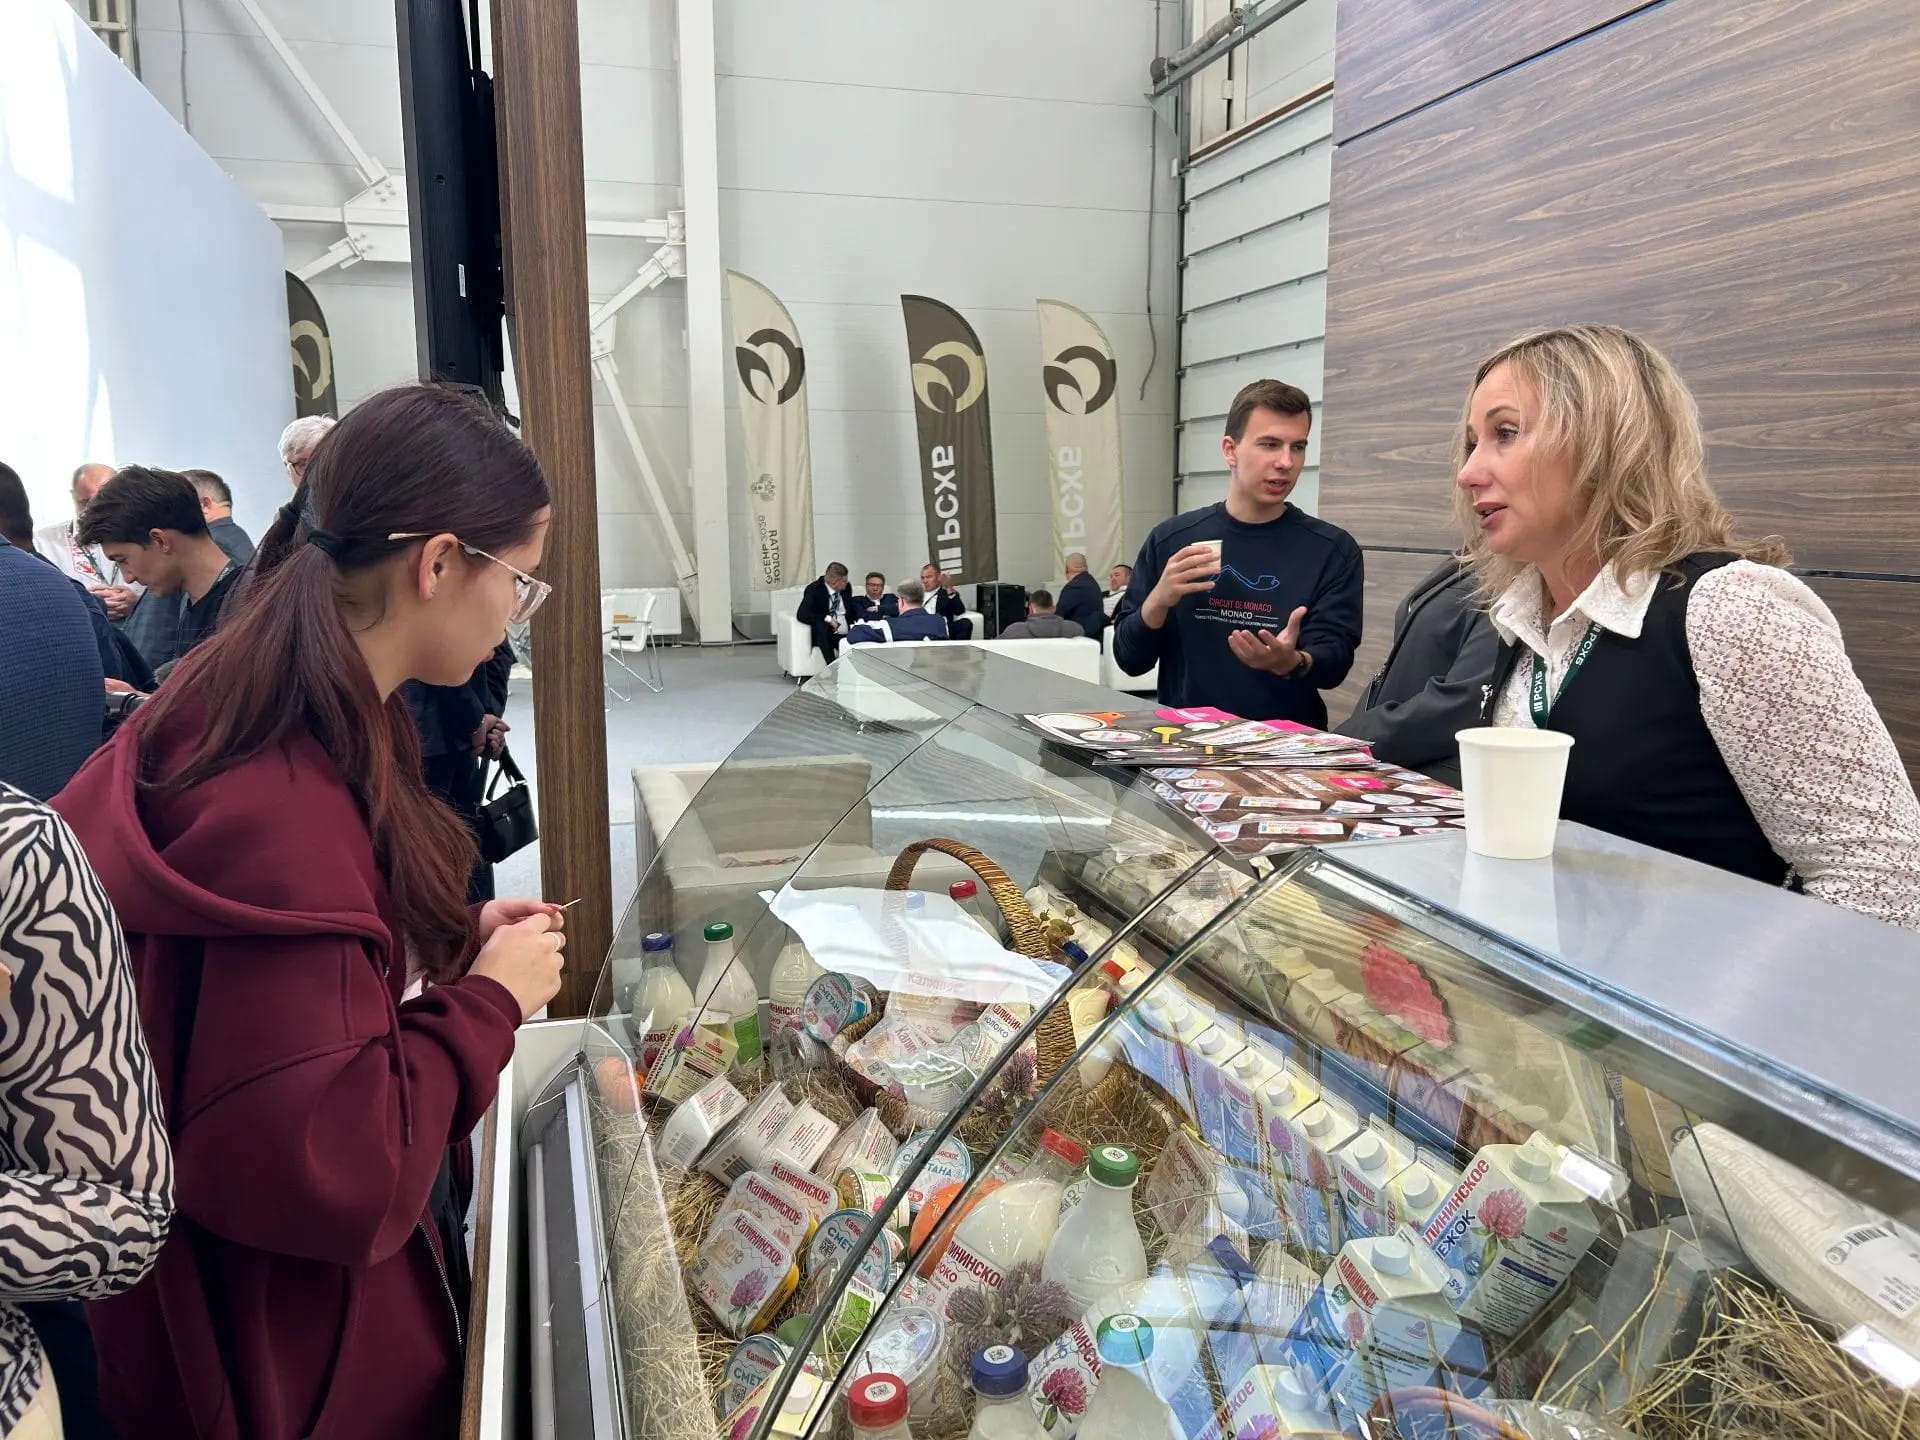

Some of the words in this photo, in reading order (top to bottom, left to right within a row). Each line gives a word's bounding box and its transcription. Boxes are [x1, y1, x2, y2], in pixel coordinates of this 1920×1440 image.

[1208, 597, 1234, 608] CIRCUIT
[1234, 600, 1243, 609] DE
[1243, 601, 1272, 613] MONACO
[1220, 609, 1253, 620] MONACO
[1575, 632, 1598, 666] РСХБ
[1533, 670, 1543, 701] РСХБ
[745, 1175, 803, 1226] Калининское
[770, 1162, 831, 1205] Калининское
[732, 1213, 785, 1267] Калининское
[1338, 1254, 1380, 1310] Калининское
